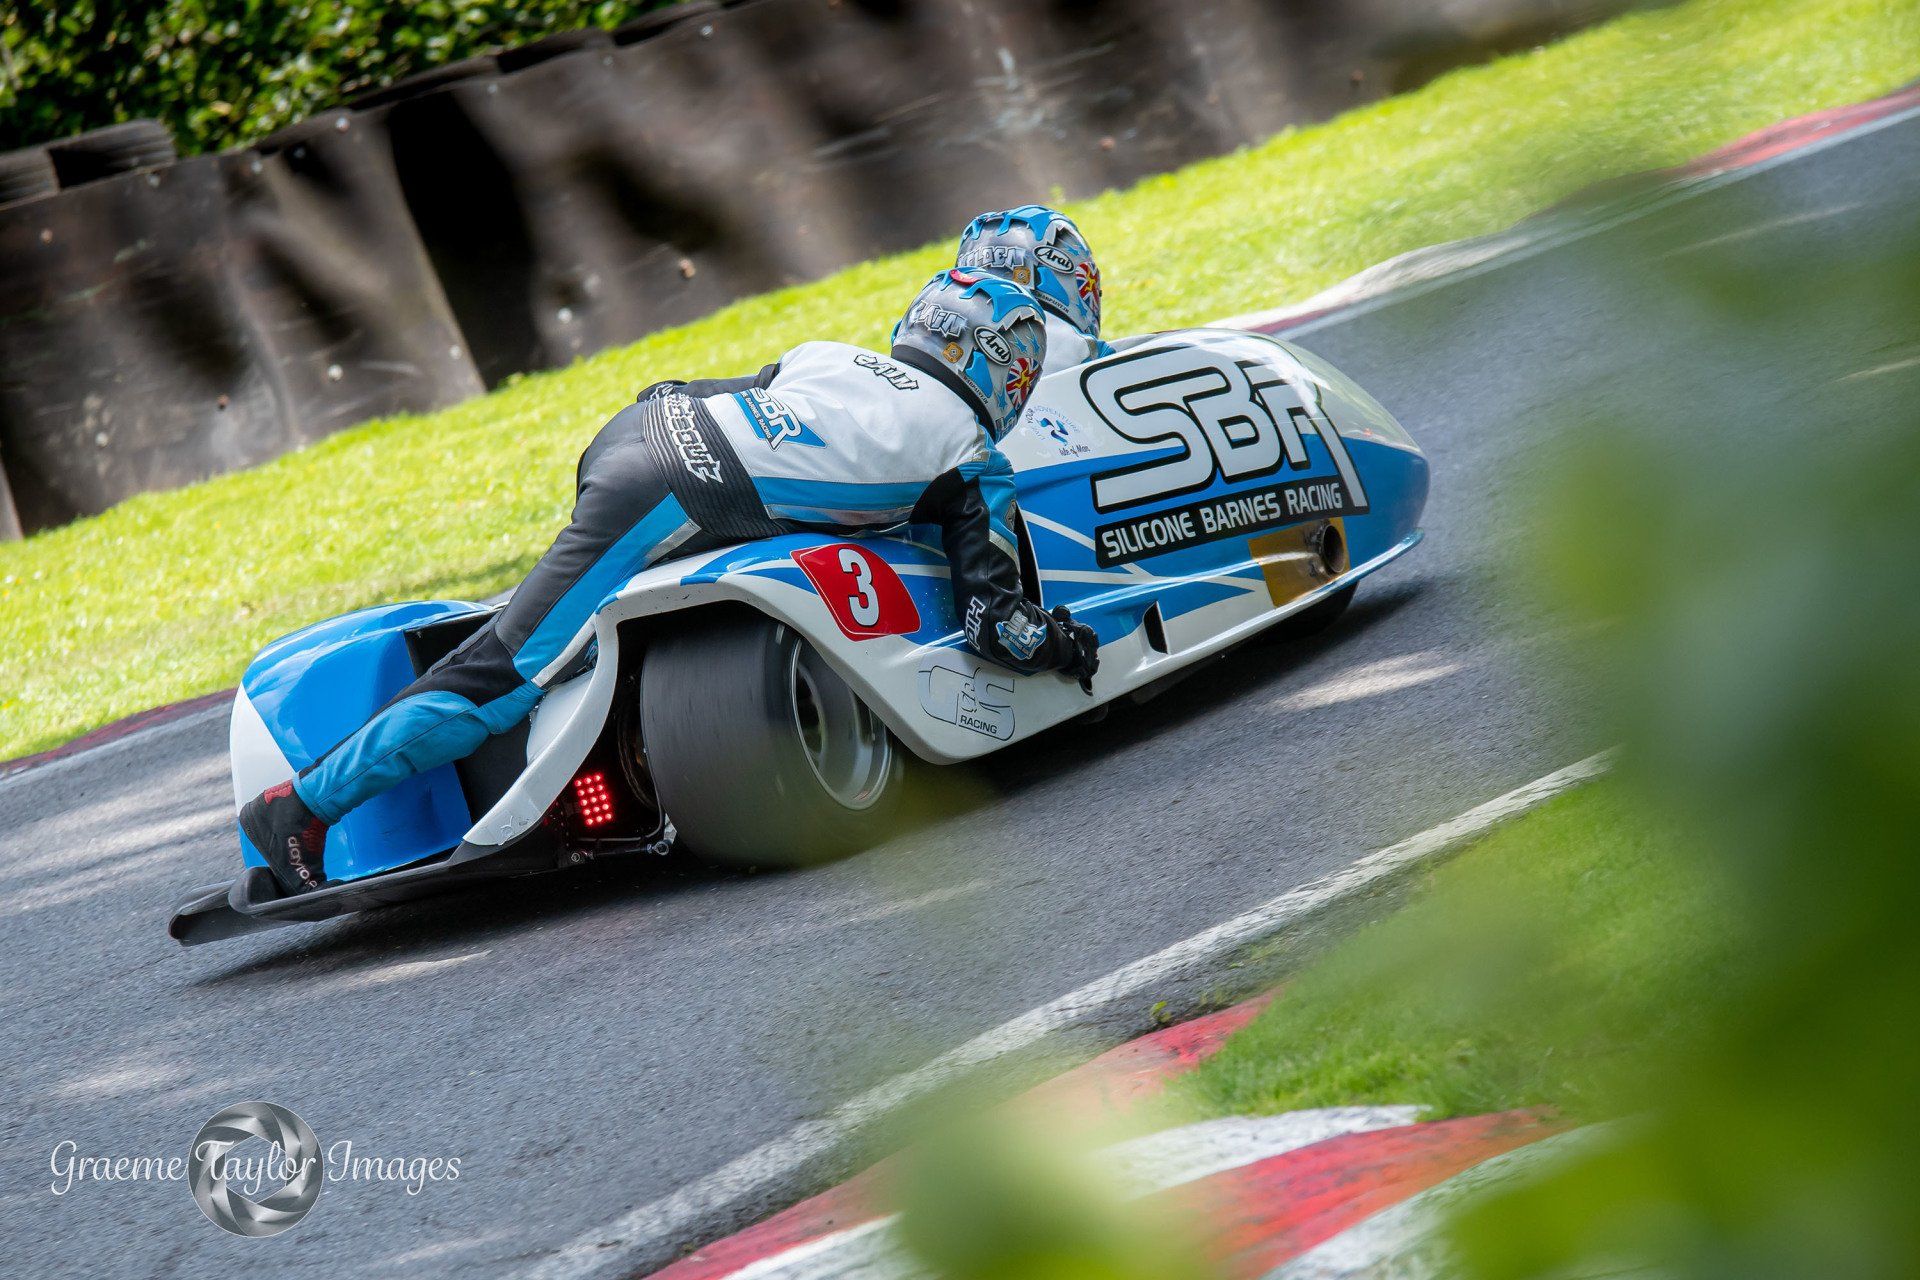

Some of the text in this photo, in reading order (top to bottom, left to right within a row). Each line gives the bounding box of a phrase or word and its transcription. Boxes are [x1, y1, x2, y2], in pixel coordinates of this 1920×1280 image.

[1038, 248, 1071, 270] Arai
[978, 332, 1010, 361] Arai
[1081, 346, 1369, 513] SBR
[1101, 482, 1343, 559] SILICONE BARNES RACING
[838, 547, 879, 627] 3
[960, 714, 998, 735] RACING
